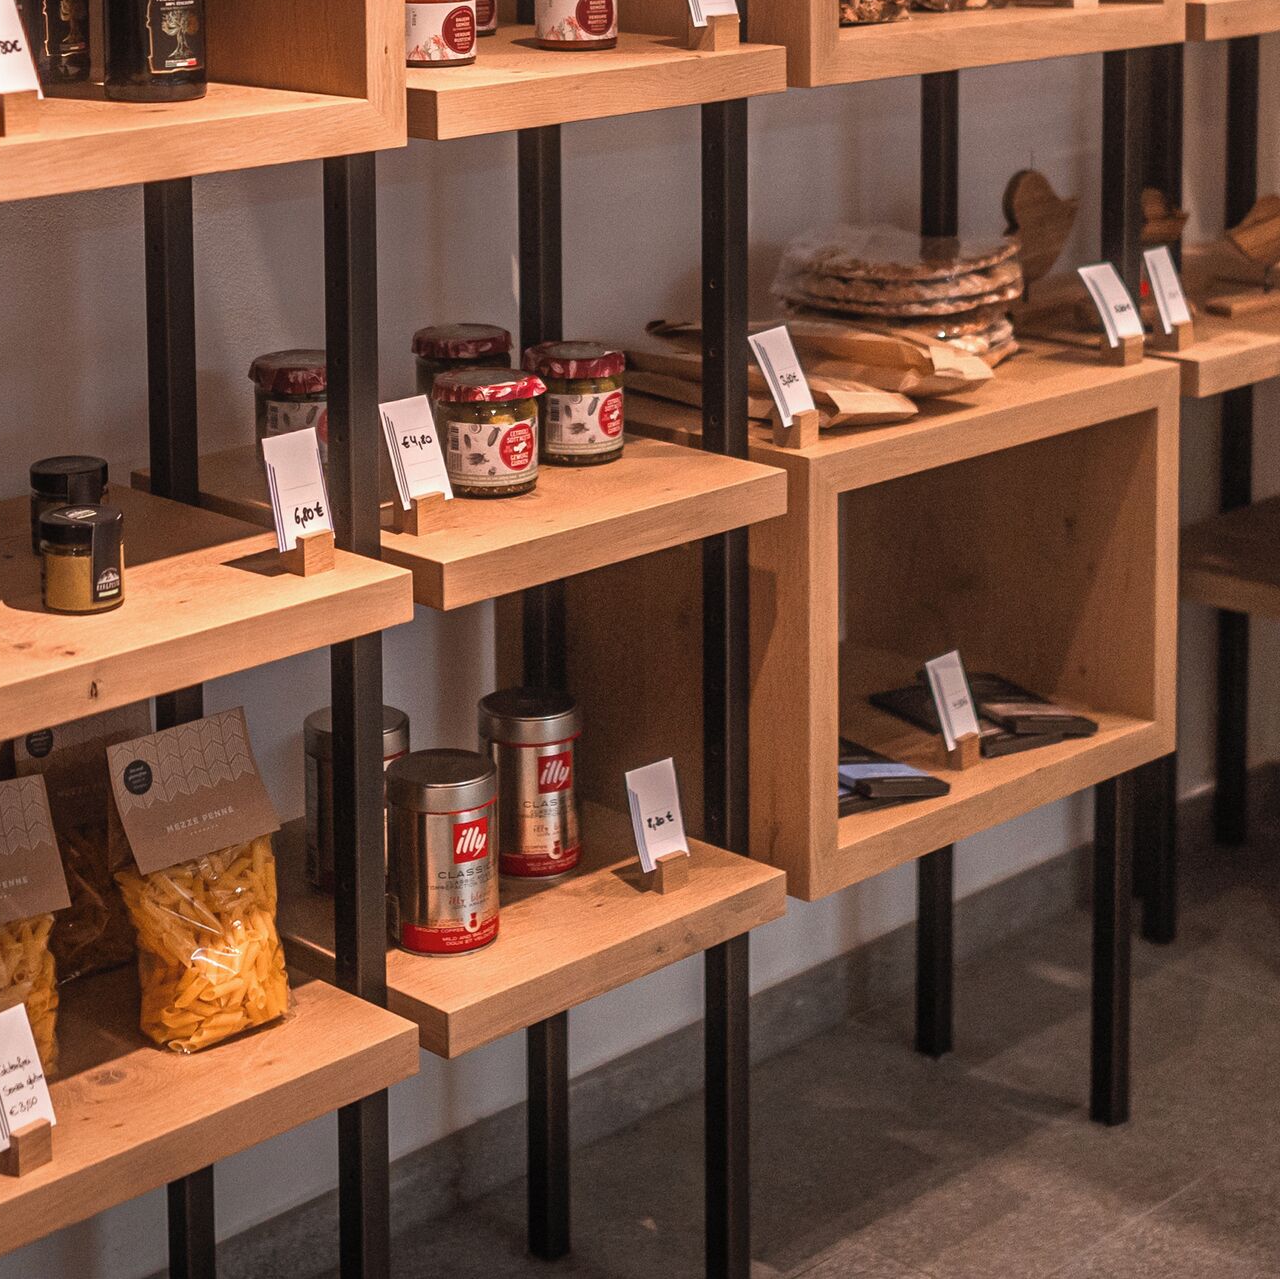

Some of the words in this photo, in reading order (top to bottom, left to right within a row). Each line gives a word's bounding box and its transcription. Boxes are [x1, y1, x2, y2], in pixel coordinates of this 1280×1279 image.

[540, 759, 570, 789] illy
[523, 799, 559, 809] CLAS
[166, 816, 200, 834] MEZZE
[202, 805, 236, 823] PENNE
[455, 826, 488, 858] illy
